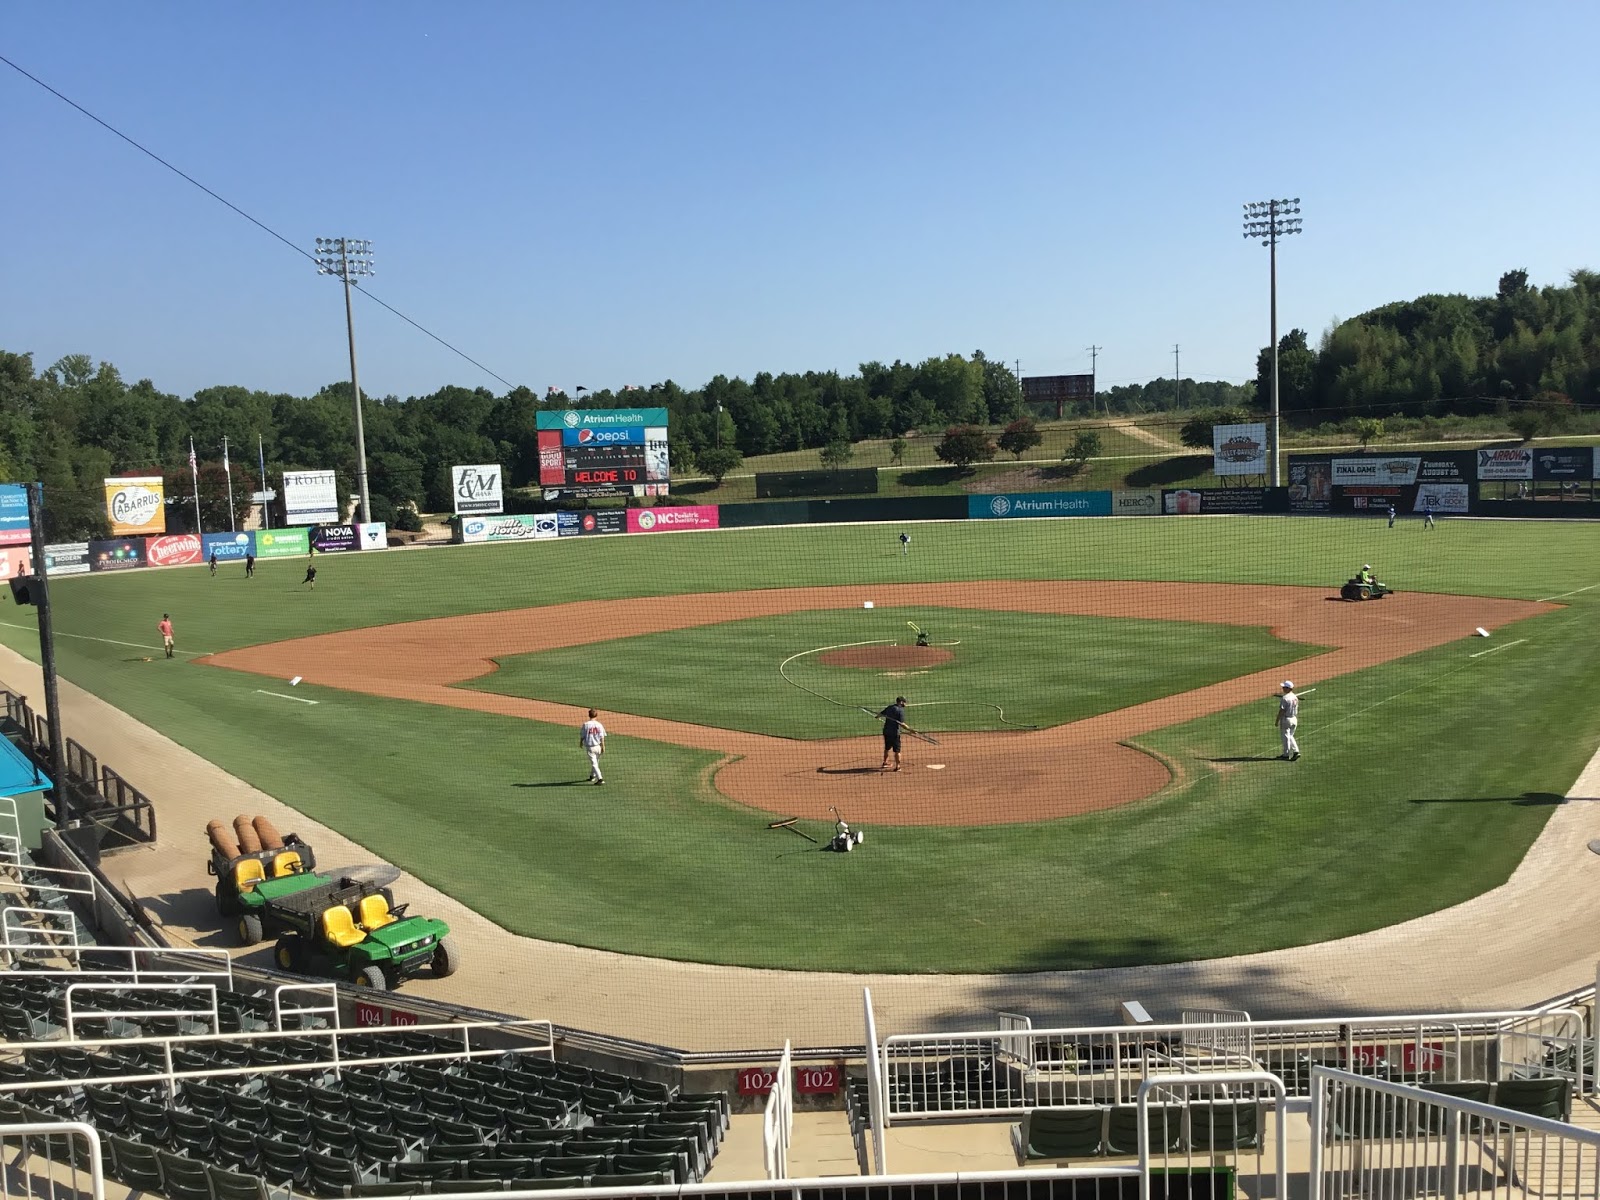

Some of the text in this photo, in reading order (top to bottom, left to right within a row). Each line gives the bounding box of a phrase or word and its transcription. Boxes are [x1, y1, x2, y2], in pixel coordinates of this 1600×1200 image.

[583, 413, 643, 424] Atrium Health
[597, 430, 629, 443] pepsi
[1491, 450, 1523, 461] ARROW
[541, 459, 562, 467] SPORT
[575, 469, 637, 482] WELCOME TO
[1336, 466, 1356, 474] FINAL
[112, 491, 160, 522] CABARRUS
[1014, 498, 1089, 511] Atrium Health
[502, 518, 522, 527] Mr.
[657, 514, 674, 524] NC
[325, 527, 354, 537] NOVA
[488, 525, 534, 536] Storage
[150, 537, 201, 561] Cheerwine
[210, 545, 249, 556] Lottery
[360, 1008, 381, 1026] 104
[743, 1073, 773, 1090] 102
[803, 1071, 834, 1088] 102
